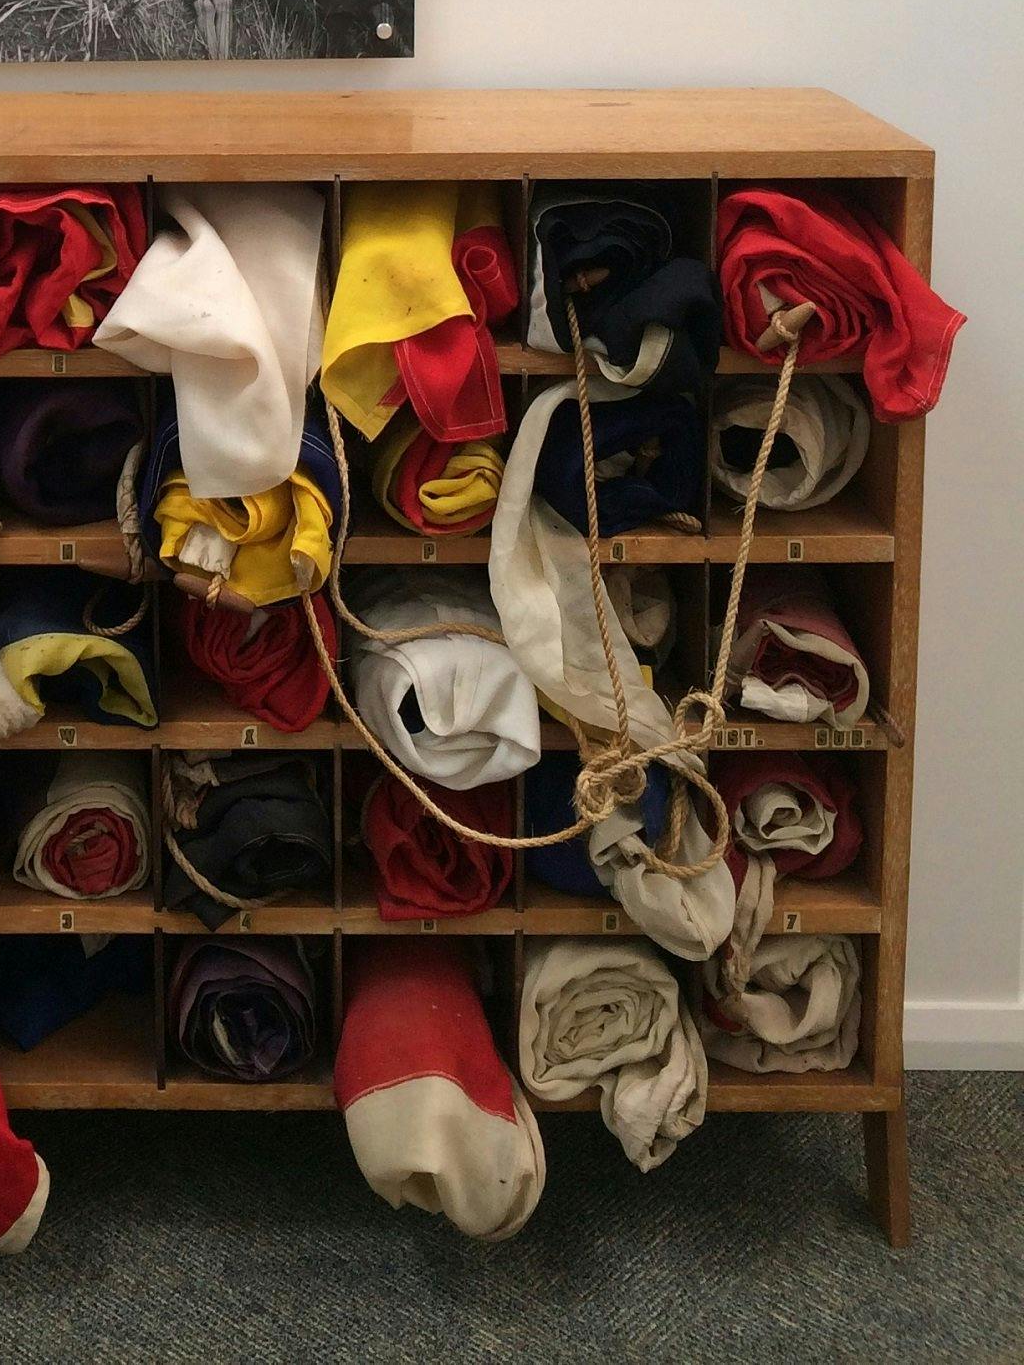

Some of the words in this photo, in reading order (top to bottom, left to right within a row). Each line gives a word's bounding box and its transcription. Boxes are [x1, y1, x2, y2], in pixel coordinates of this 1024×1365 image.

[424, 543, 434, 559] P
[612, 543, 623, 561] Q
[59, 728, 76, 744] W
[62, 913, 73, 929] 3
[242, 913, 251, 929] 4
[787, 914, 798, 930] 7
